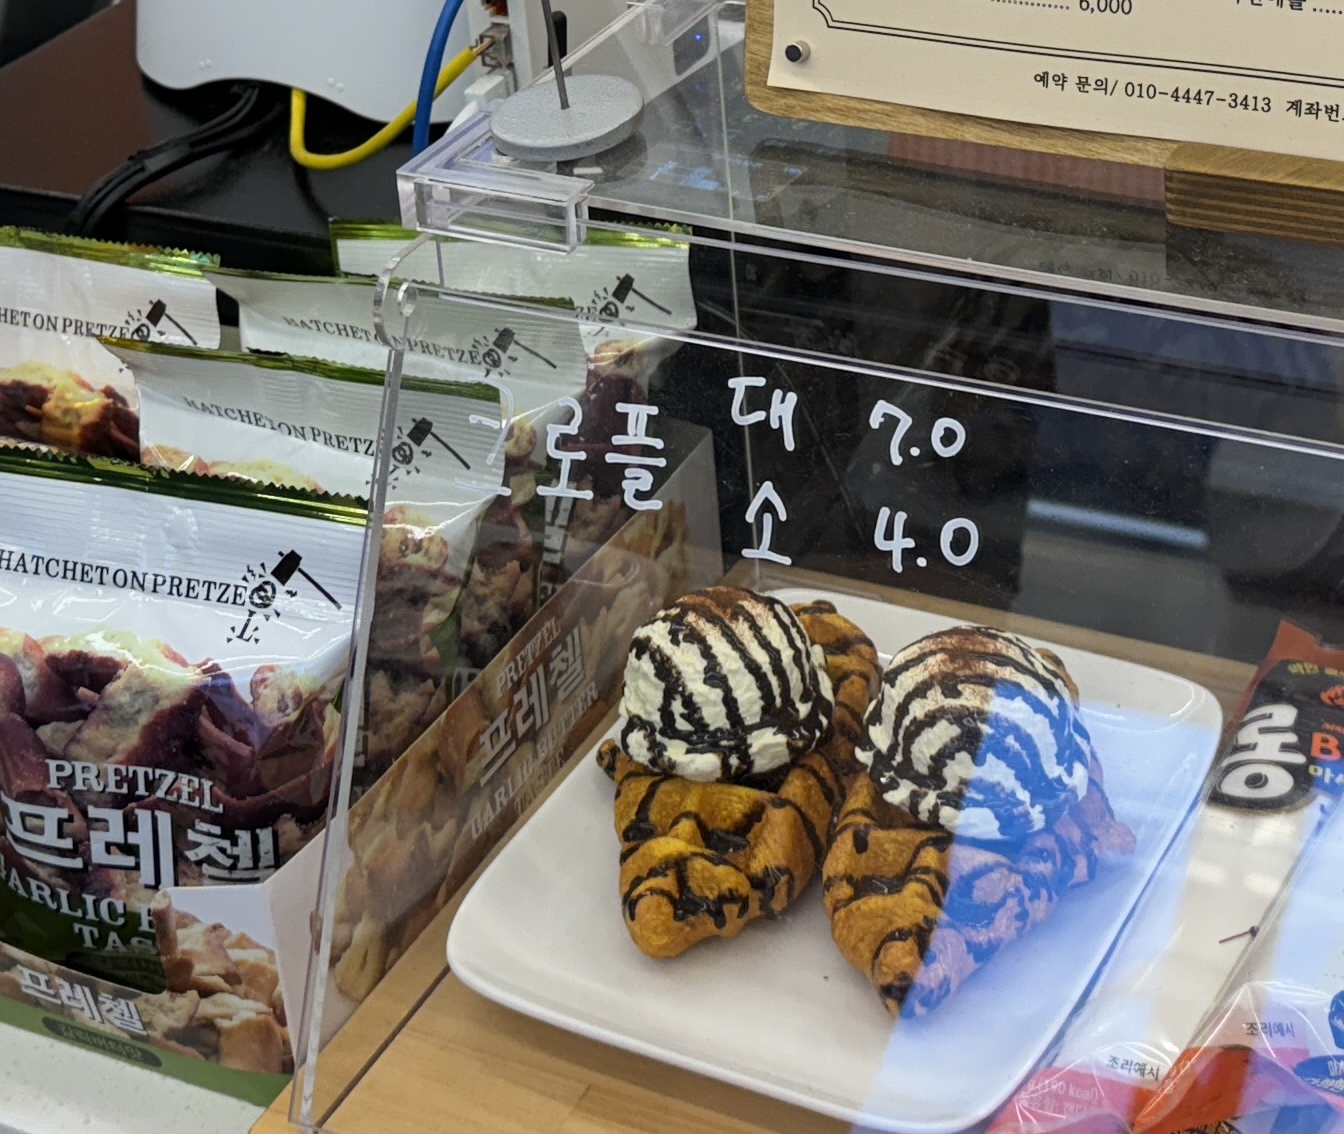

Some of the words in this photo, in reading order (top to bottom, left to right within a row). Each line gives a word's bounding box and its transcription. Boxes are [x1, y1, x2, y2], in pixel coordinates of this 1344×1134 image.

[1033, 70, 1069, 92] 예약
[1074, 75, 1119, 97] 문의/
[1124, 81, 1272, 113] 010-4447-3413
[728, 376, 797, 452] 대
[870, 399, 966, 466] 7.0
[742, 480, 792, 566] 소
[874, 506, 980, 573] 4.0
[496, 618, 561, 698] PRETZEL
[480, 626, 585, 787] 프레첼
[45, 758, 224, 814] PRETZEL
[1, 791, 278, 890] 프레첼
[17, 964, 148, 1036] 프레첼
